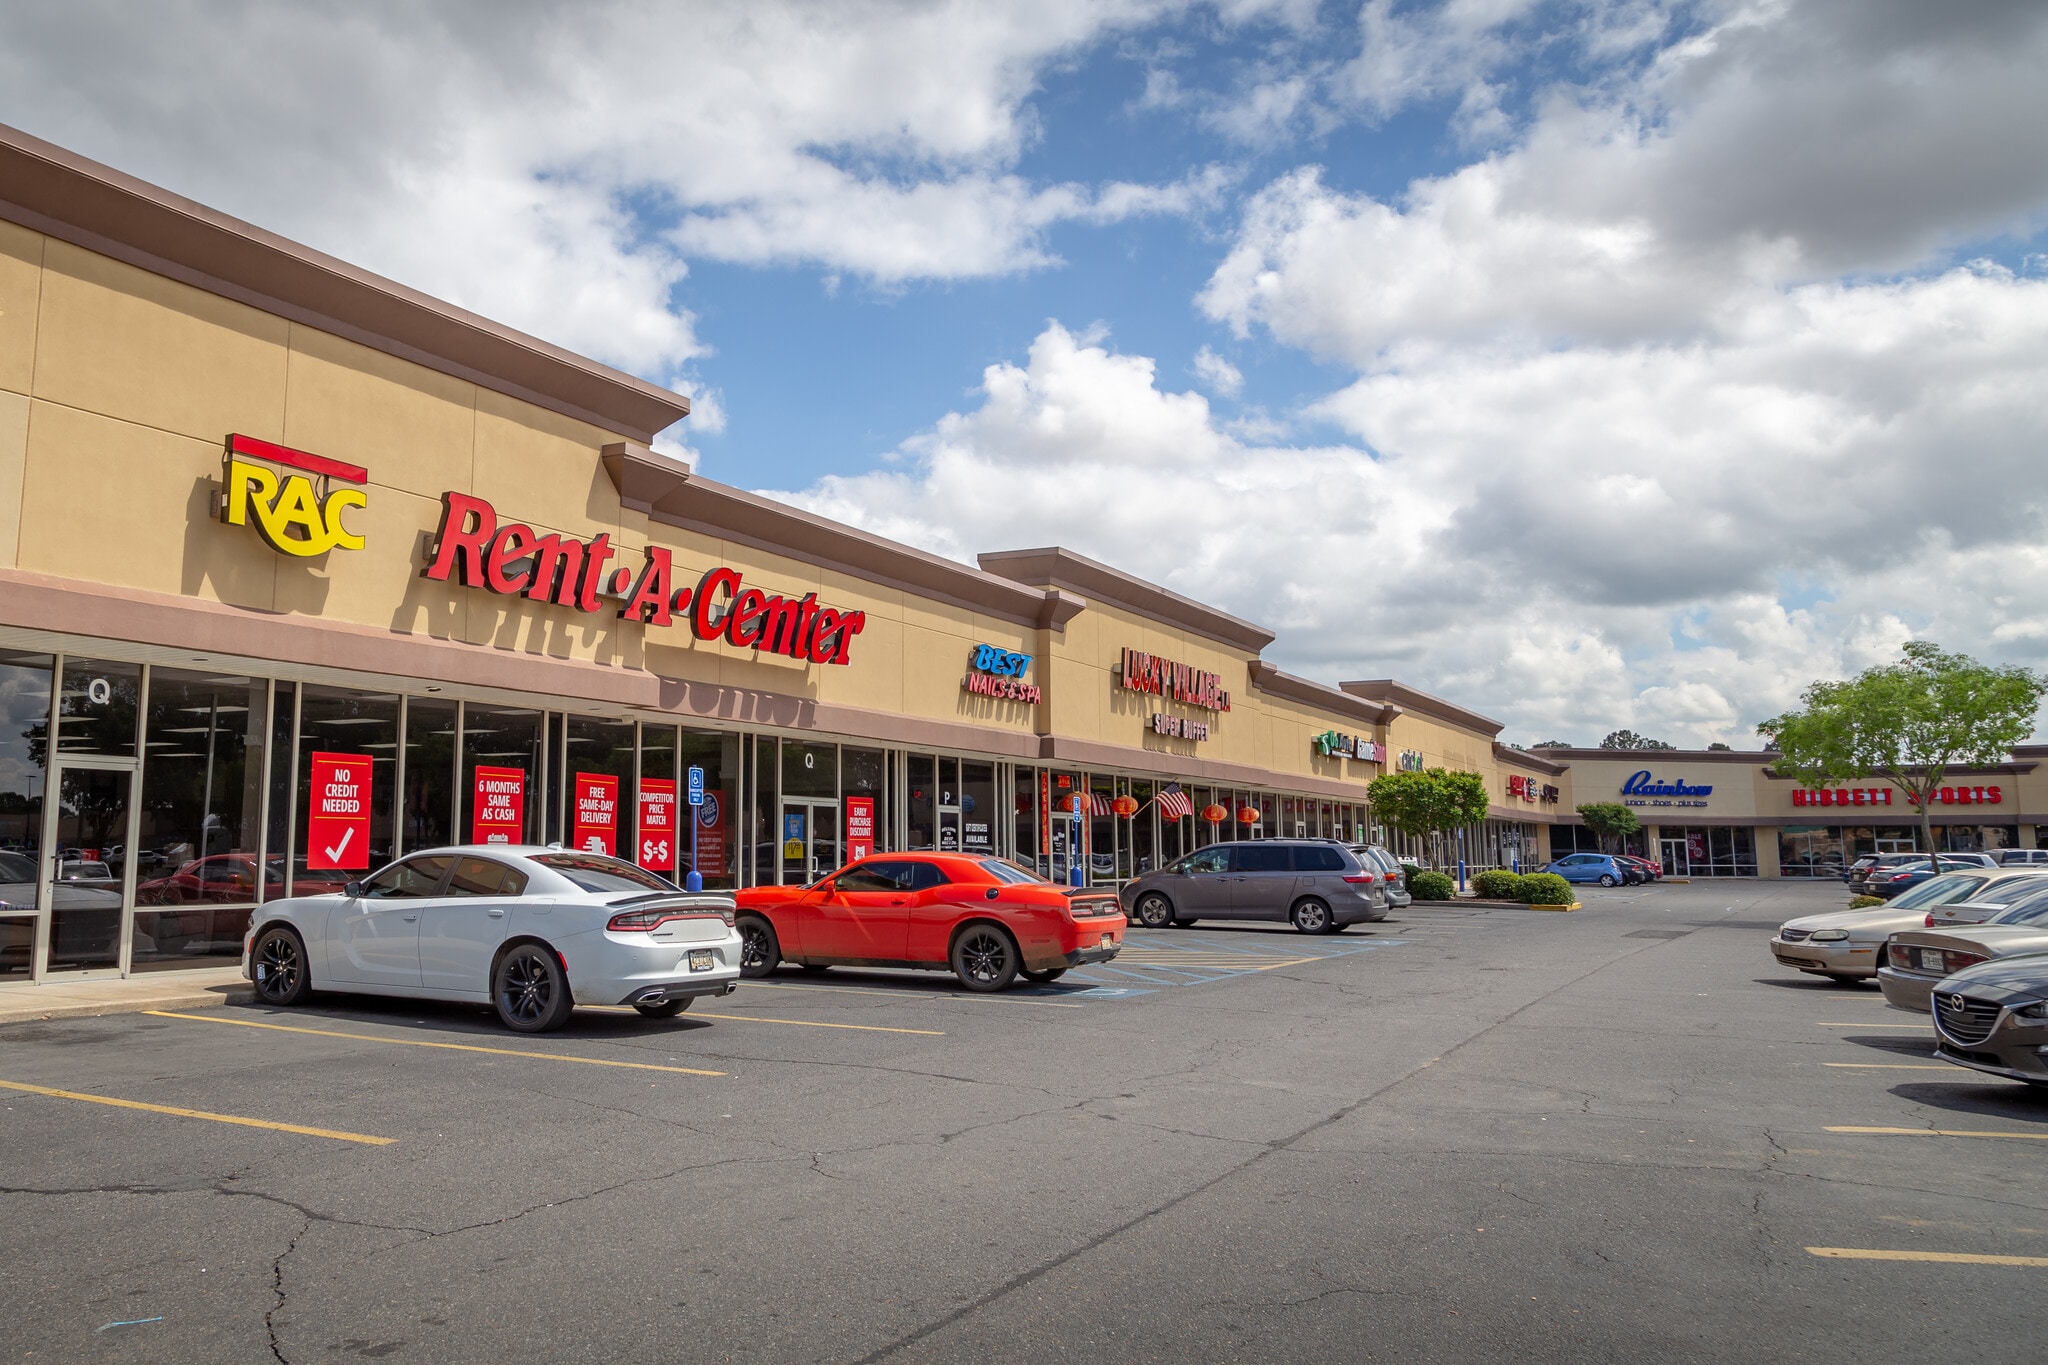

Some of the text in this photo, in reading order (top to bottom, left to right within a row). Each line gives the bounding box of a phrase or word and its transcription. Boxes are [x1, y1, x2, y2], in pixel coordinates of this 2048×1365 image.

[224, 459, 367, 558] RAC
[975, 643, 1034, 679] BEST
[1121, 646, 1170, 698] LUCKY
[1171, 661, 1221, 712] VILLAGE
[88, 678, 111, 706] Q
[1152, 713, 1209, 742] SUPER BUFFET
[805, 752, 814, 769] Q
[334, 768, 351, 783] NO
[478, 780, 521, 795] 6 MONTHS
[1621, 770, 1714, 796] Rainbow
[325, 783, 359, 798] CREDIT
[589, 786, 606, 799] FREE
[640, 791, 674, 804] COMPETITOR
[1792, 788, 1893, 807] HIBBETT
[487, 794, 511, 808] SAME
[579, 798, 615, 812] SAME-DAY
[944, 791, 951, 805] P
[322, 798, 361, 813] NEEDED
[648, 804, 665, 815] PRICE
[700, 803, 717, 819] FREE
[854, 807, 868, 816] EARLY
[481, 808, 515, 822] AS CASH
[580, 811, 612, 825] DELIVERY
[646, 814, 667, 826] MATCH
[849, 817, 872, 827] PURCHASE
[849, 827, 871, 837] DISCOUNT
[966, 835, 988, 844] AVAILABLE
